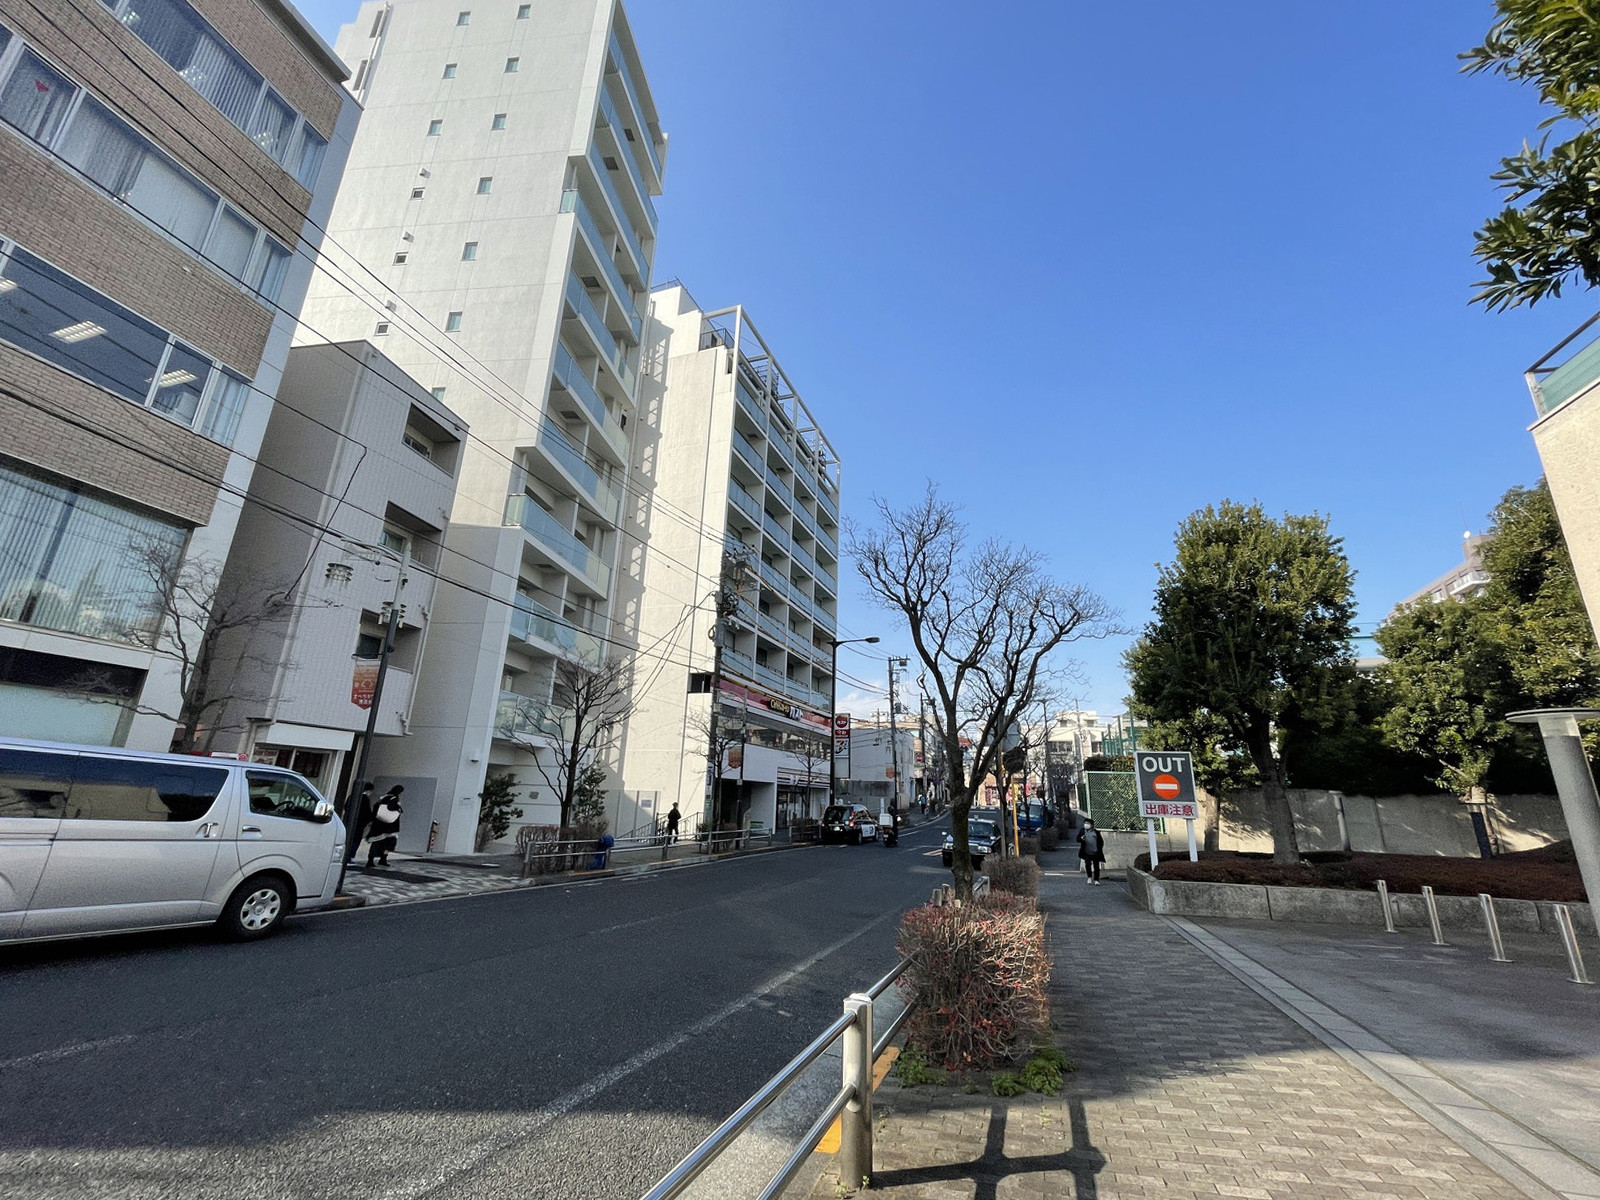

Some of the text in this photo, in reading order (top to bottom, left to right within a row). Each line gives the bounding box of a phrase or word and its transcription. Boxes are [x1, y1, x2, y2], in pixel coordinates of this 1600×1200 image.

[1142, 756, 1185, 773] OUT
[1145, 803, 1194, 816] 出庫注意
